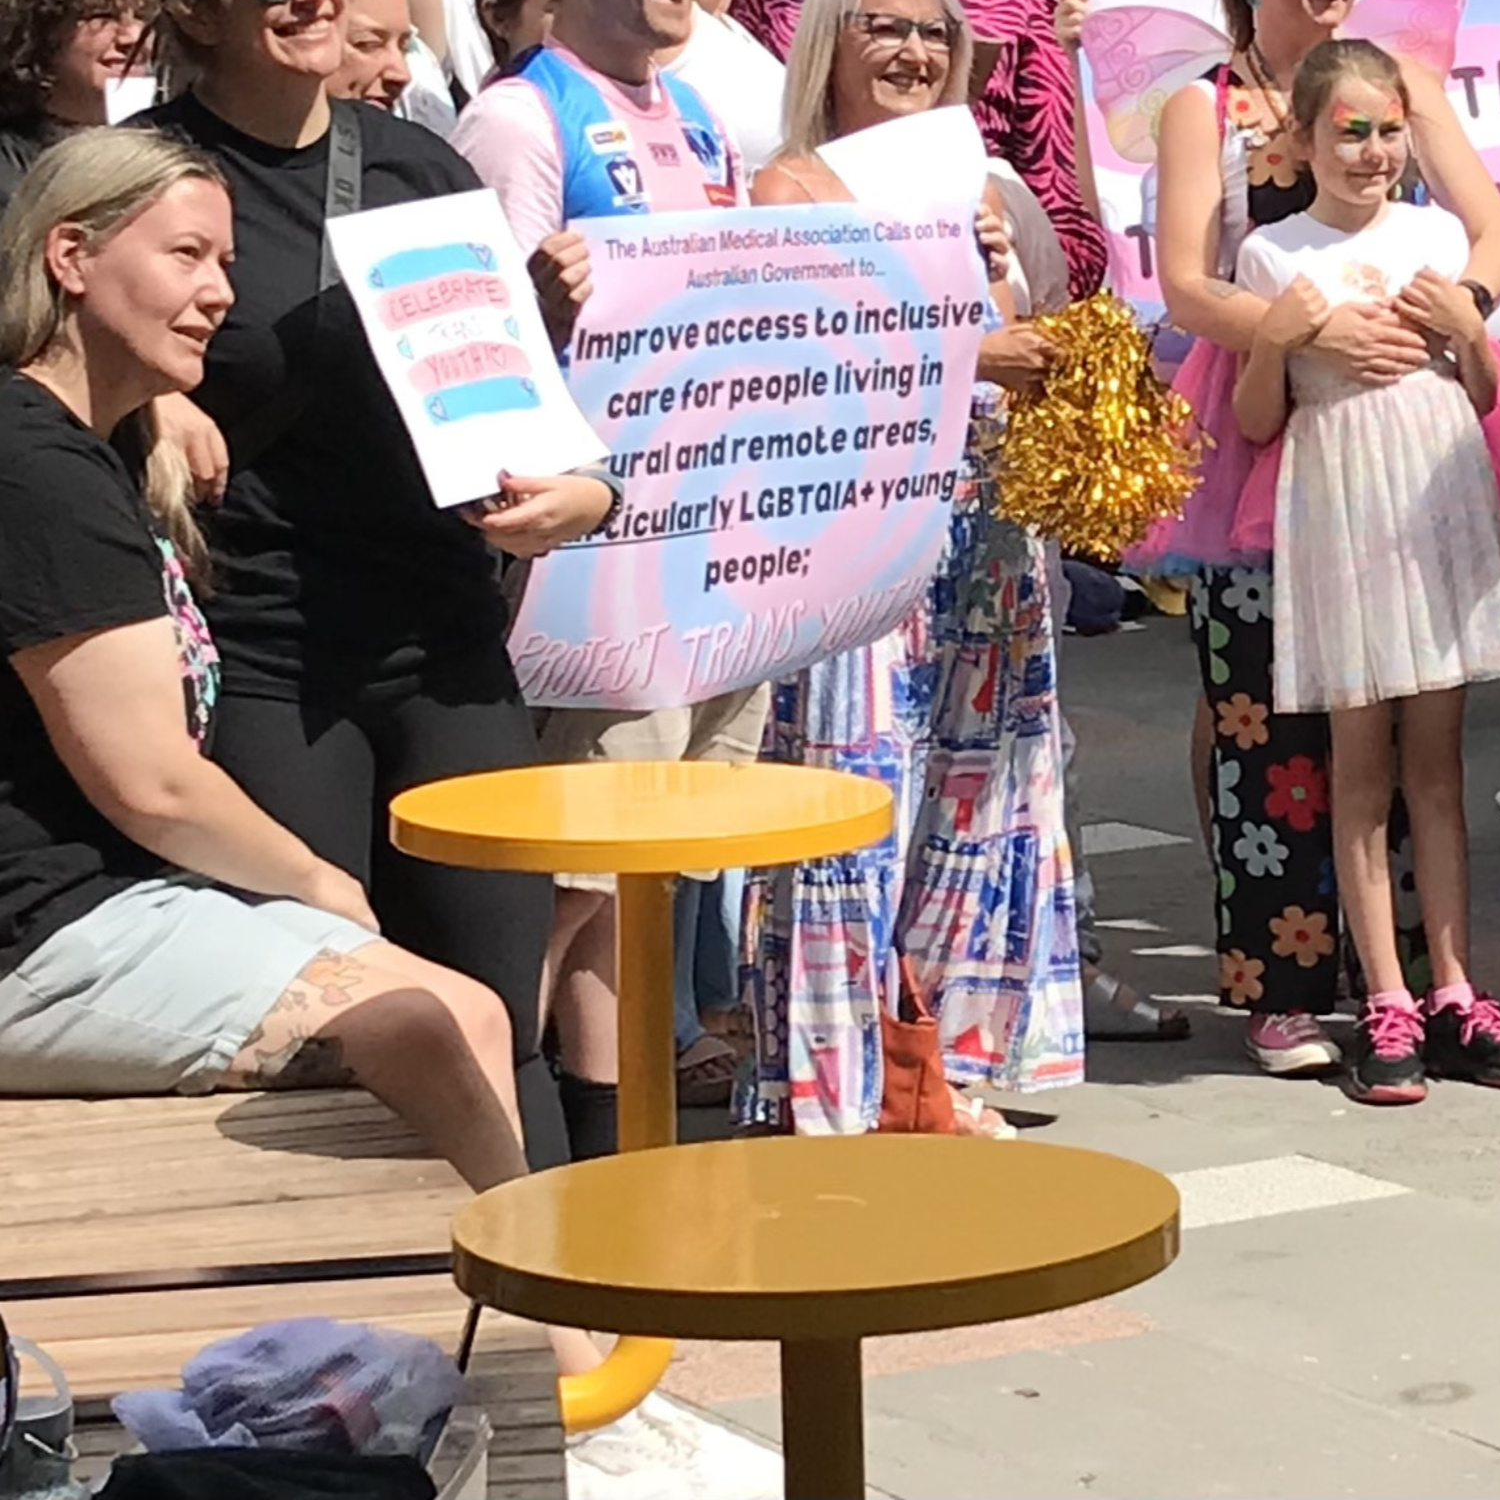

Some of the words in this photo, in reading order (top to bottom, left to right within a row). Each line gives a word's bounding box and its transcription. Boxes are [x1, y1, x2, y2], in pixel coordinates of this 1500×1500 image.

[605, 237, 637, 259] The
[641, 232, 716, 258] Australian
[719, 228, 778, 252] Medical
[782, 223, 871, 248] Association
[874, 220, 912, 243] Calls
[914, 223, 934, 240] on
[937, 218, 961, 239] the
[685, 263, 758, 289] Australian
[761, 257, 856, 283] Government
[388, 276, 504, 323] CELEBRATE
[576, 319, 699, 364] Improve
[705, 311, 808, 348] access
[814, 306, 848, 338] to
[853, 294, 984, 336] inclusive
[607, 386, 676, 419] care
[680, 377, 725, 412] for
[728, 366, 828, 410] people
[834, 357, 914, 398] living
[918, 354, 943, 388] in
[600, 441, 671, 479] ural
[675, 434, 727, 472] and
[730, 425, 849, 464] remote
[853, 416, 938, 451] areas,
[881, 467, 958, 508] young
[704, 545, 811, 592] people;
[513, 622, 671, 699] PROTECT
[681, 599, 808, 696] TRANS
